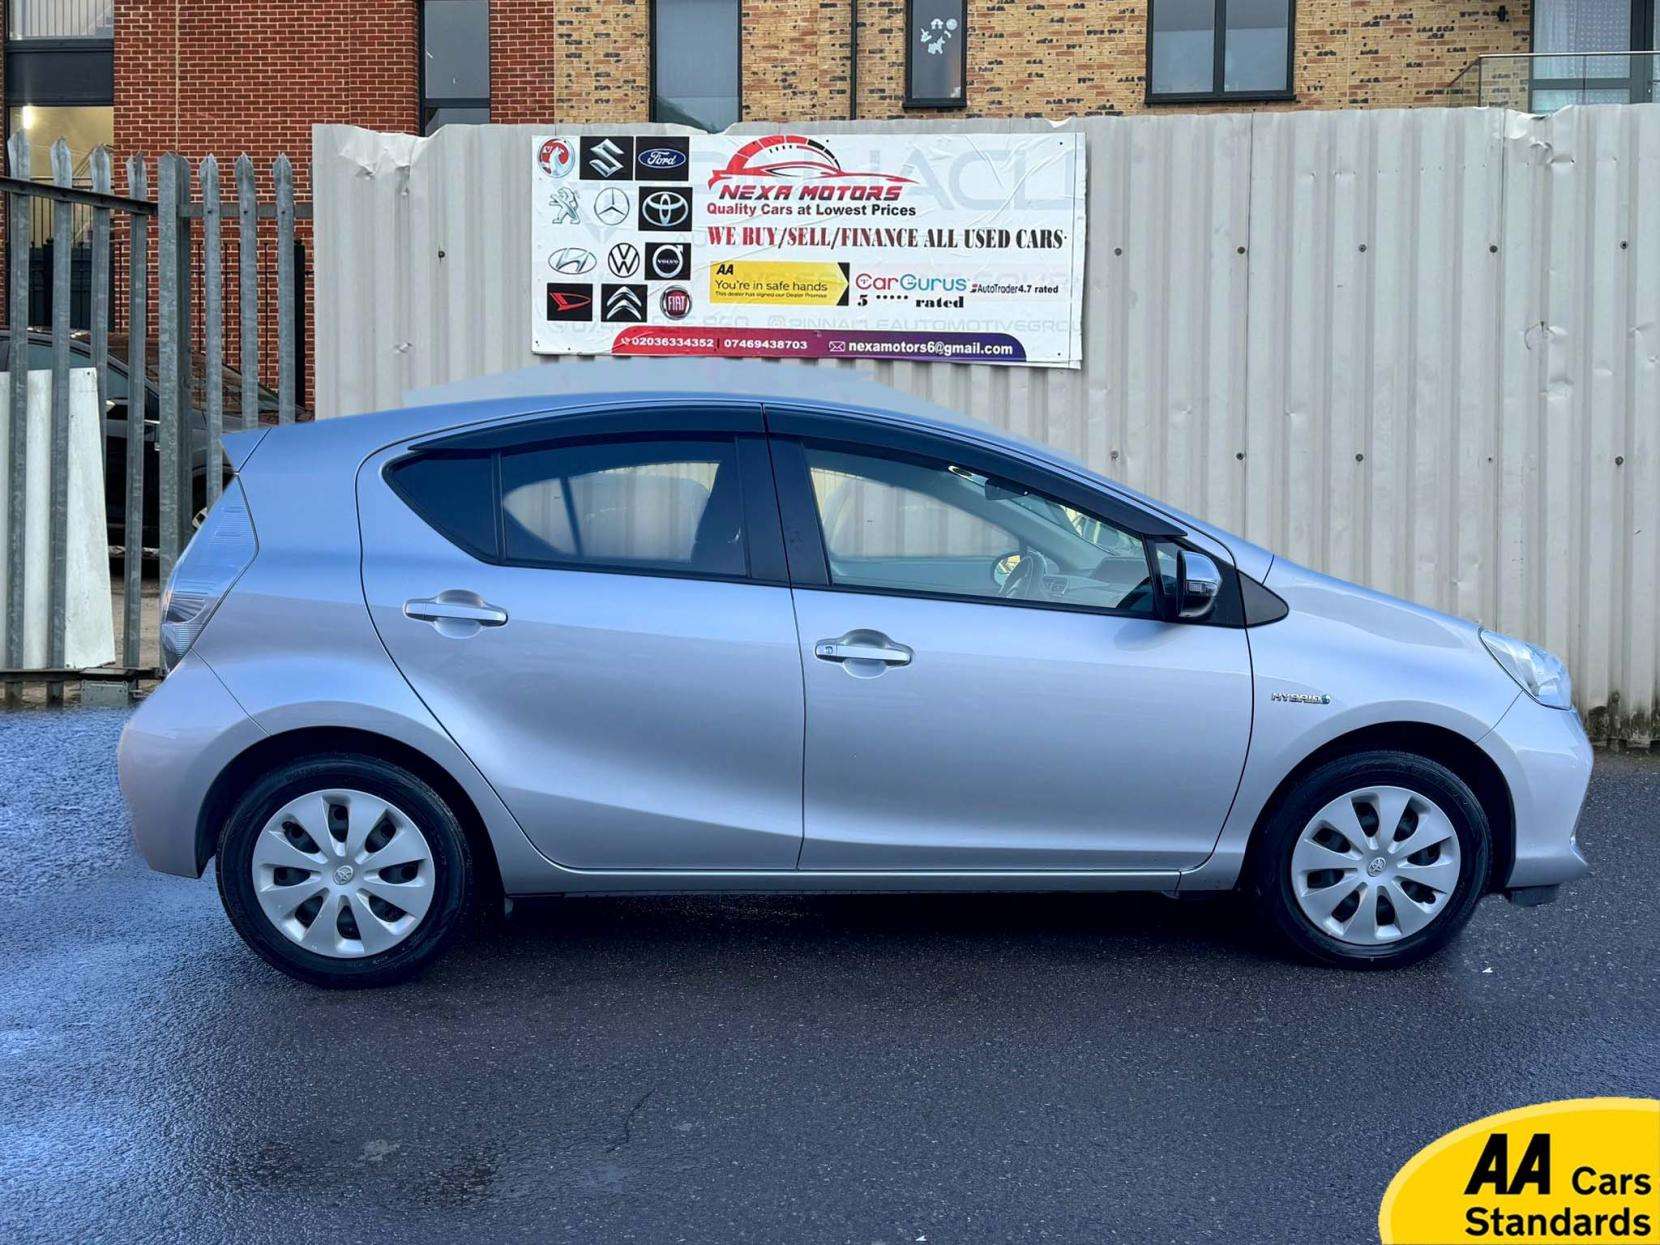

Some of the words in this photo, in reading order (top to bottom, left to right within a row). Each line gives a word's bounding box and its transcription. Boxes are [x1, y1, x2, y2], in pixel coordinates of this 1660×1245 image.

[647, 151, 677, 165] Ford
[718, 185, 793, 200] NEXA
[798, 185, 903, 201] MOTORS
[707, 203, 757, 217] Quality
[761, 203, 793, 215] Cars
[797, 204, 811, 215] at
[816, 203, 867, 216] Lowest
[871, 204, 916, 216] Prices
[707, 226, 736, 246] WE
[924, 228, 958, 248] ALL
[964, 228, 1011, 249] USED
[1016, 228, 1063, 249] CARS
[716, 264, 734, 276] AA
[715, 280, 750, 290] You're
[753, 281, 763, 290] in
[766, 281, 789, 291] safe
[792, 281, 828, 292] hands
[1034, 285, 1059, 294] rated
[668, 295, 686, 311] FIAT
[857, 294, 868, 307] 5
[916, 296, 964, 308] rated
[632, 338, 714, 347] 02036334352
[724, 339, 808, 349] 07469438703
[848, 340, 1013, 356] nexamotors6@gmail.com
[1271, 692, 1321, 704] HYBRID
